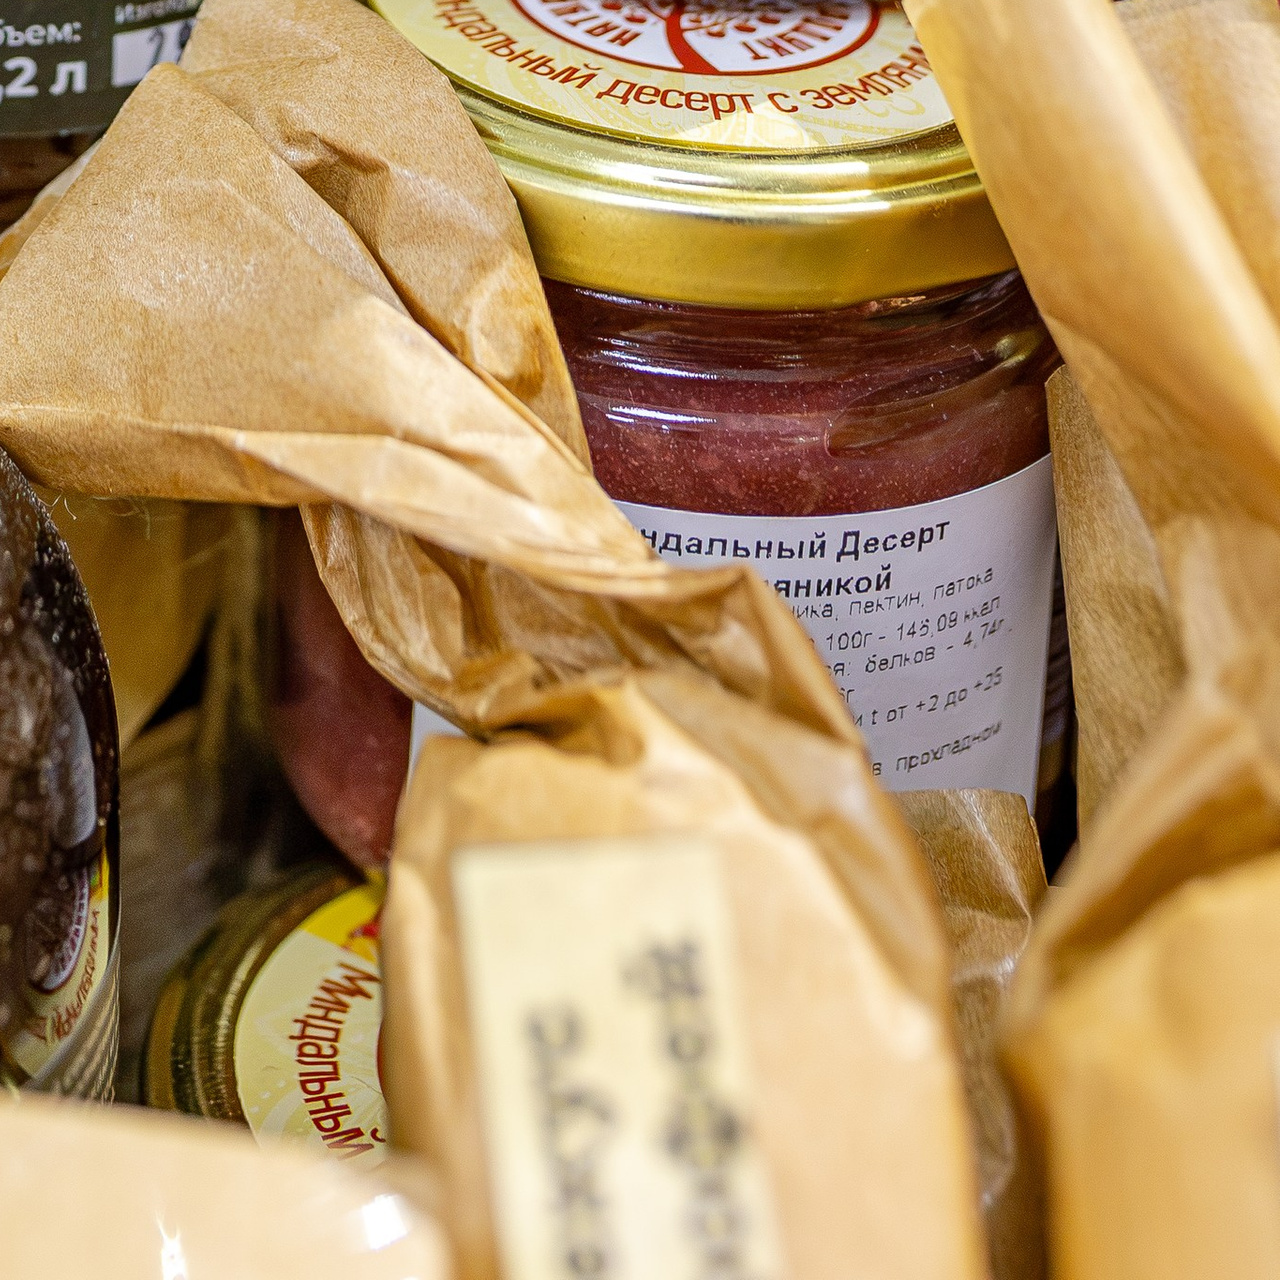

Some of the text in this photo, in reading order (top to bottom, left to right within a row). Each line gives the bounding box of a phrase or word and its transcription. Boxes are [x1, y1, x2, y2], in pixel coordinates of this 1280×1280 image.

[49, 61, 88, 96] л
[595, 78, 755, 121] десерт
[767, 92, 799, 114] с
[641, 520, 951, 563] ндальный Десерт
[774, 563, 892, 600] яникой
[849, 590, 925, 617] пектин,
[826, 629, 872, 652] 100г
[865, 646, 936, 673] белков
[886, 704, 908, 723] от
[915, 694, 939, 713] +2
[944, 687, 969, 710] до
[896, 719, 1003, 774] прохладном
[289, 961, 387, 1161] Миндальный
